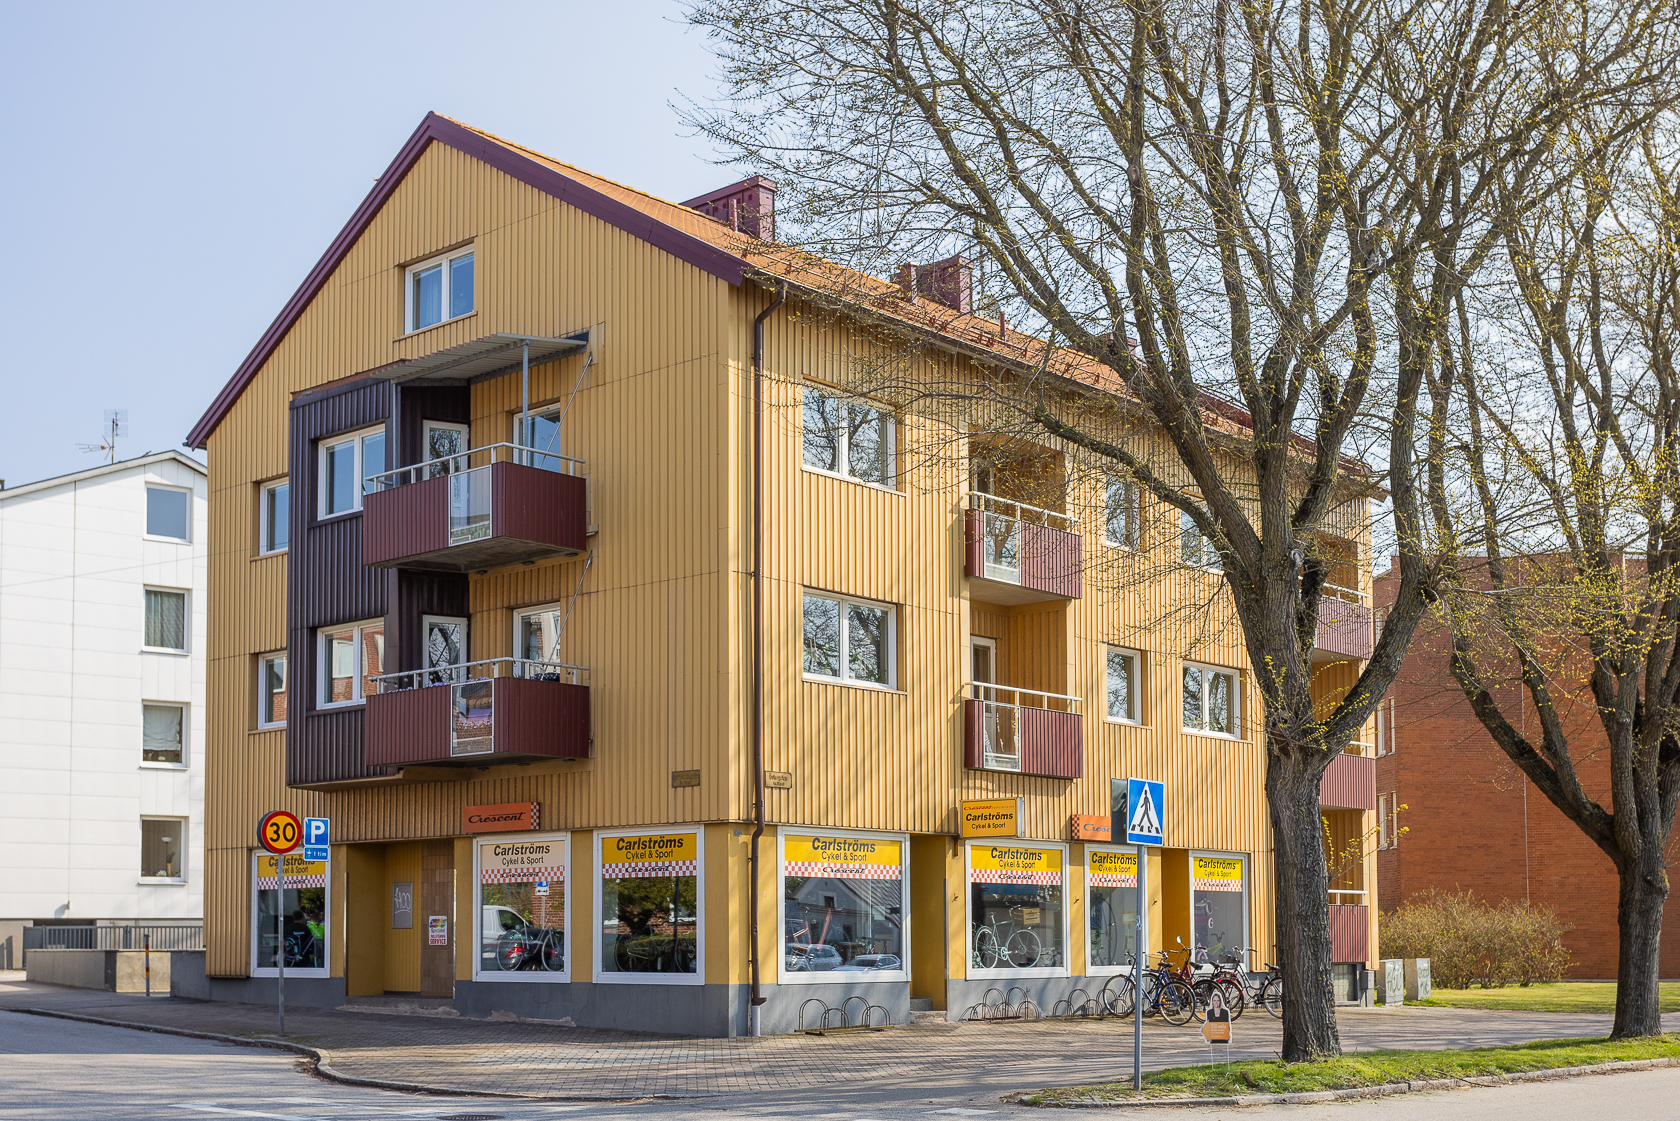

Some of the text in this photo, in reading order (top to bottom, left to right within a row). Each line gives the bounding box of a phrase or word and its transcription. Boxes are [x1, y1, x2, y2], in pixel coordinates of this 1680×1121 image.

[468, 811, 526, 824] Crescent
[965, 811, 1014, 822] Carlströms
[269, 822, 296, 842] 30
[310, 820, 326, 844] P
[1083, 823, 1112, 832] Cresc
[494, 843, 550, 856] Carlströms
[616, 836, 684, 851] Carlströms
[812, 836, 876, 853] Carlströms
[626, 849, 674, 862] Cykel & Sport
[822, 850, 867, 862] Cykel & Sport
[990, 847, 1042, 861] Carlströms
[1092, 852, 1136, 866] Carlströms
[268, 854, 316, 868] Calström
[502, 856, 544, 867] Cykel & Sport
[998, 860, 1036, 870] Cykel & Sport
[1198, 858, 1236, 870] Carlströms
[275, 866, 290, 874] Ckel
[296, 865, 308, 874] Sport
